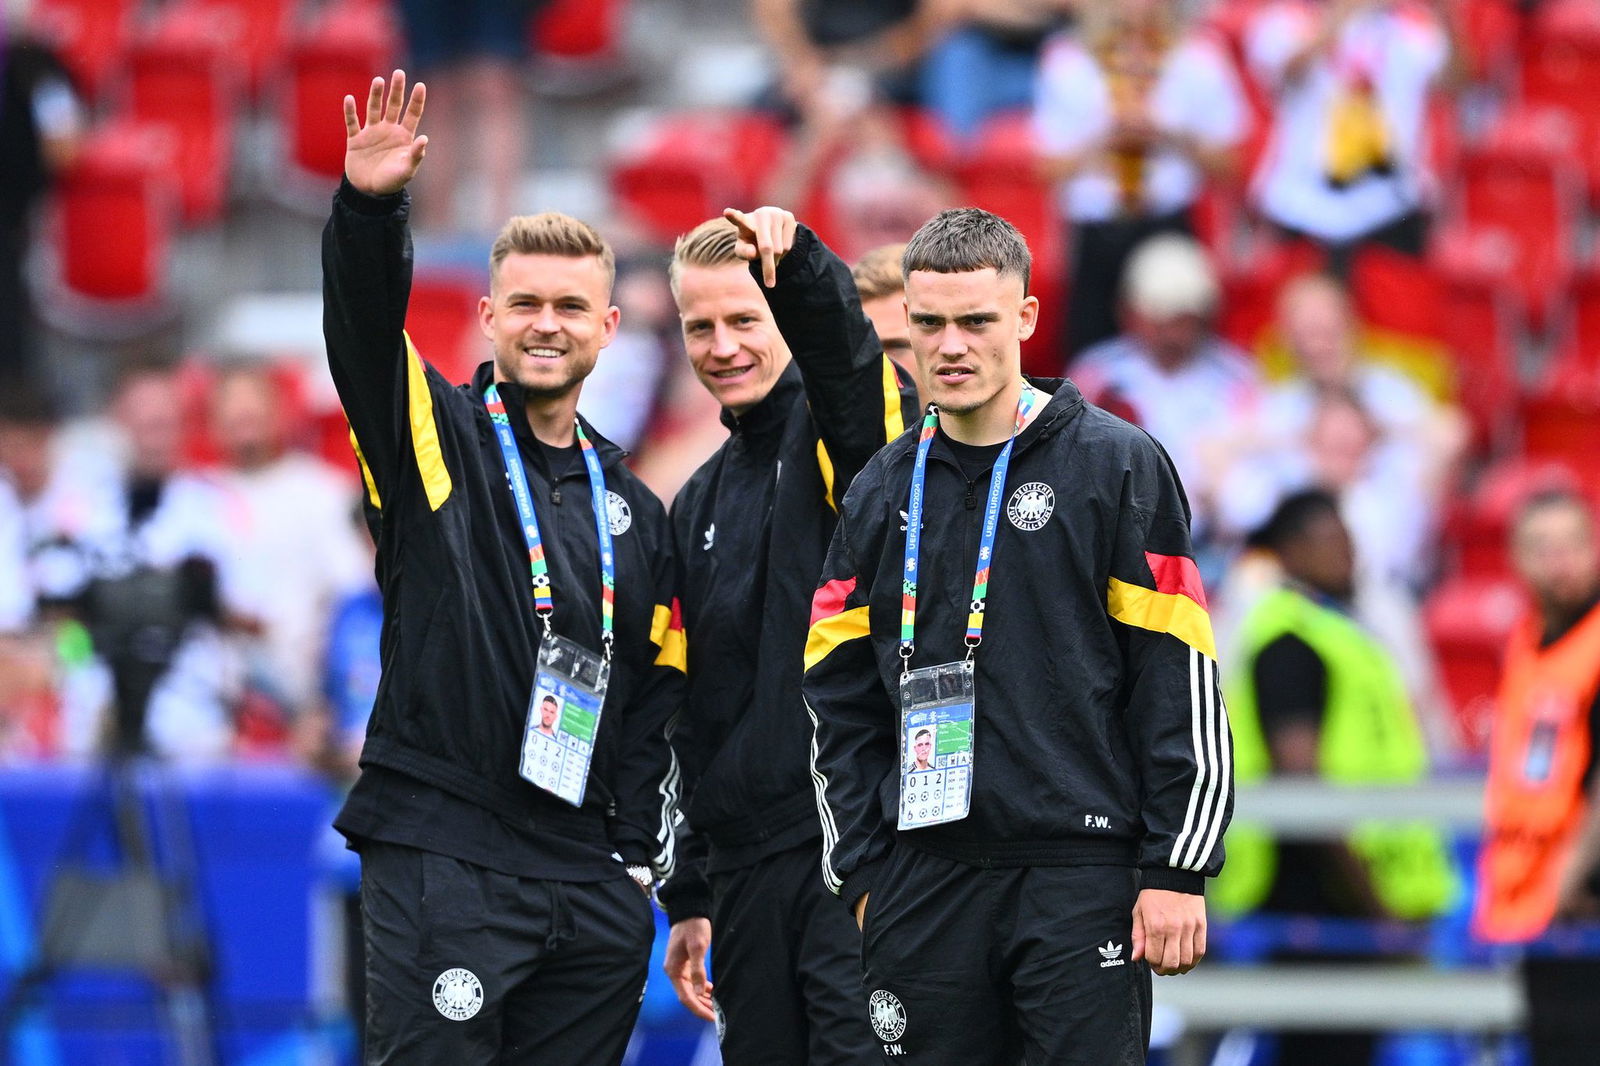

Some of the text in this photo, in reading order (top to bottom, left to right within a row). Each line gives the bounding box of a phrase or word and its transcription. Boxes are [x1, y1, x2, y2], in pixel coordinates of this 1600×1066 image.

[986, 471, 1003, 538] UEFAEURO2024
[909, 483, 920, 550] UEFAEURO2024
[909, 773, 942, 788] 0 1 2
[1084, 814, 1112, 829] F.W.
[1100, 958, 1125, 968] adidas
[883, 1043, 907, 1056] F.W.
